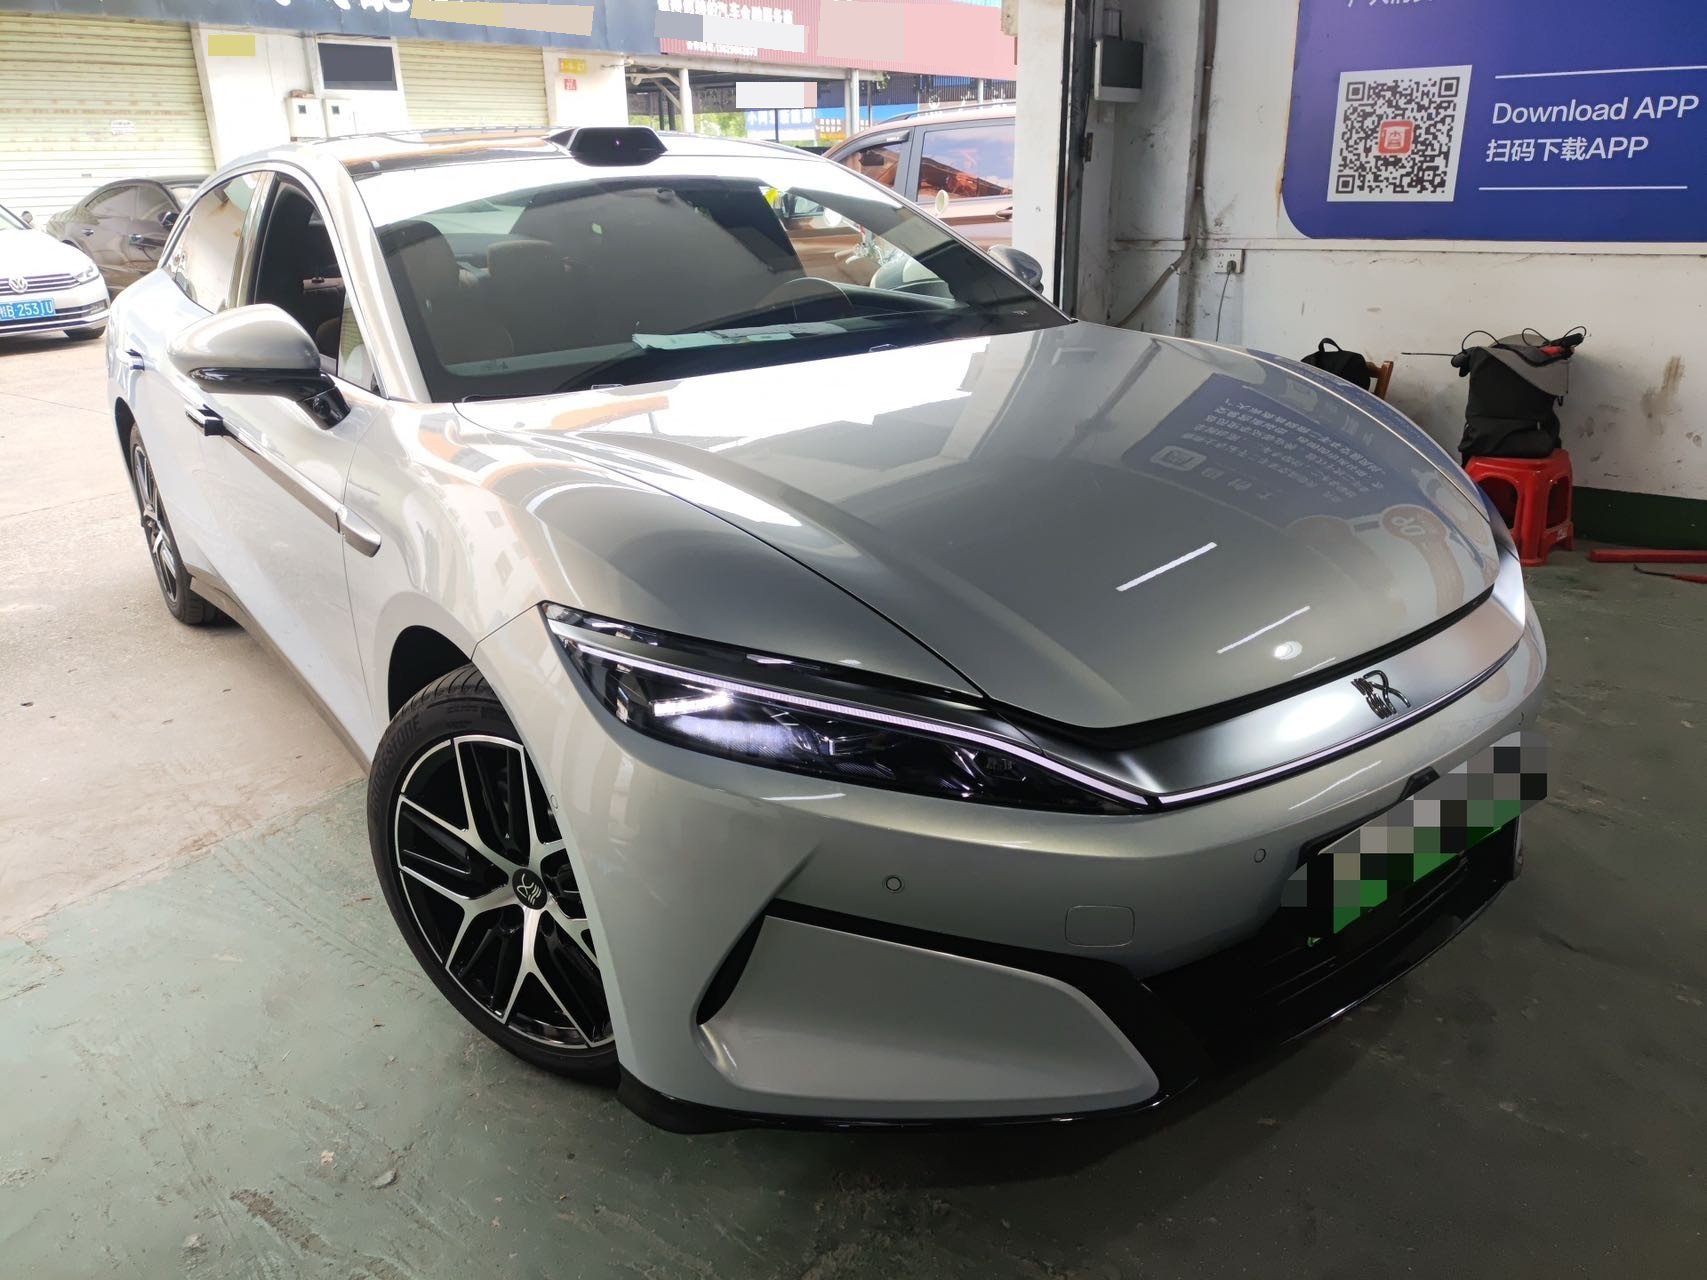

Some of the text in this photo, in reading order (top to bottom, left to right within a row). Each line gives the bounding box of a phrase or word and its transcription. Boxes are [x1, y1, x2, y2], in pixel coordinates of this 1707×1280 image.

[1492, 95, 1699, 125] Download APP
[1485, 136, 1649, 163] 扫码下载APP
